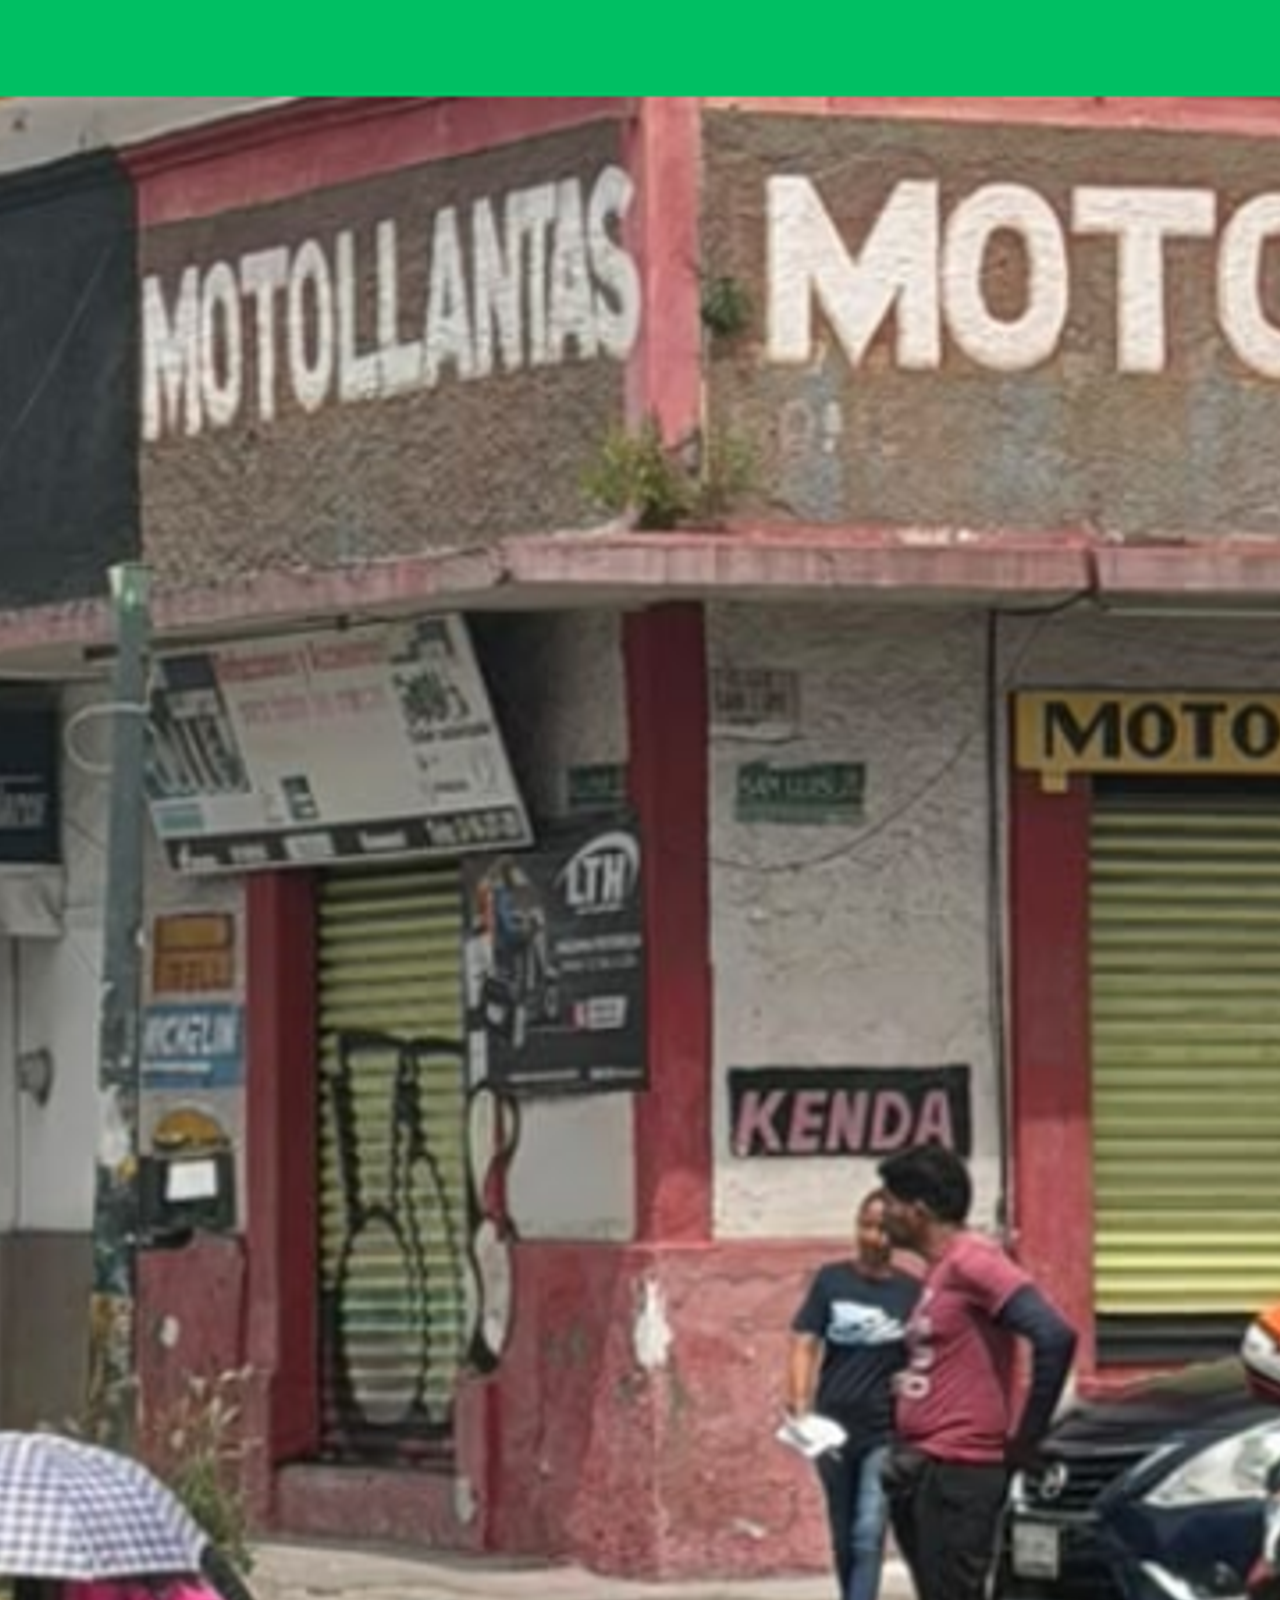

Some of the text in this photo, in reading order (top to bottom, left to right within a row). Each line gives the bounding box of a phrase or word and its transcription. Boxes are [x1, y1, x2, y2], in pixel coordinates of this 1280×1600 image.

[142, 165, 640, 442] MOTOLLANTAS
[566, 851, 625, 905] LTH
[735, 1090, 954, 1156] KENDA
